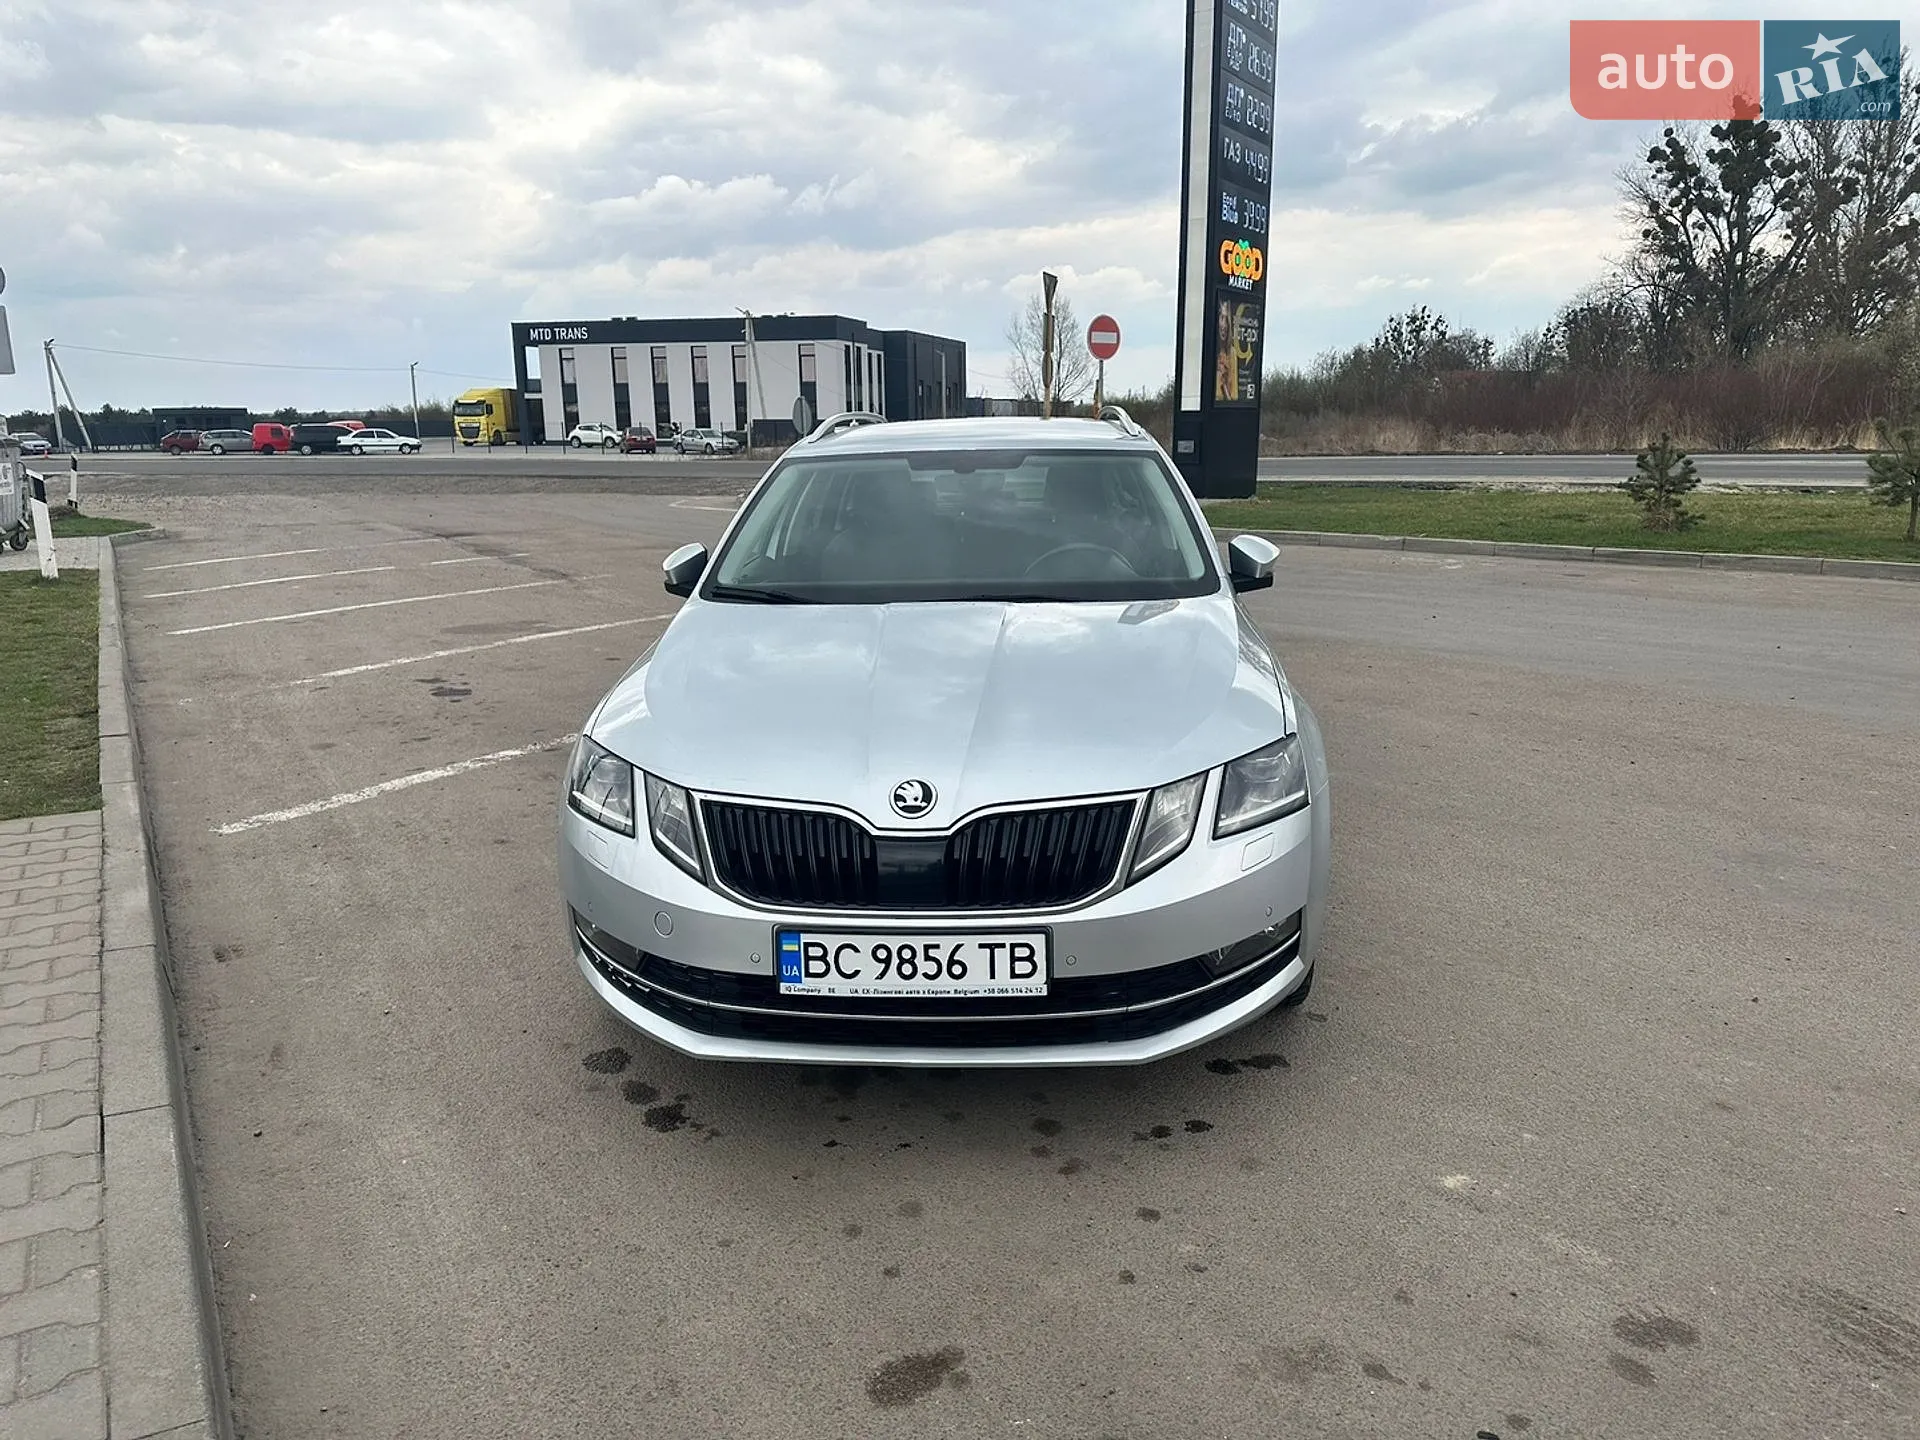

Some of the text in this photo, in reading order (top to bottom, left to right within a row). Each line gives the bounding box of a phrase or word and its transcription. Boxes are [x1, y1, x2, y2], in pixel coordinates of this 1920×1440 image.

[1224, 137, 1241, 164] ГАЗ
[1220, 240, 1263, 282] GOOD
[1228, 275, 1253, 291] MARKET
[530, 327, 588, 341] MTD TRANS
[803, 942, 1038, 981] BC 9856 TB
[782, 965, 800, 977] UA
[793, 986, 821, 994] Company
